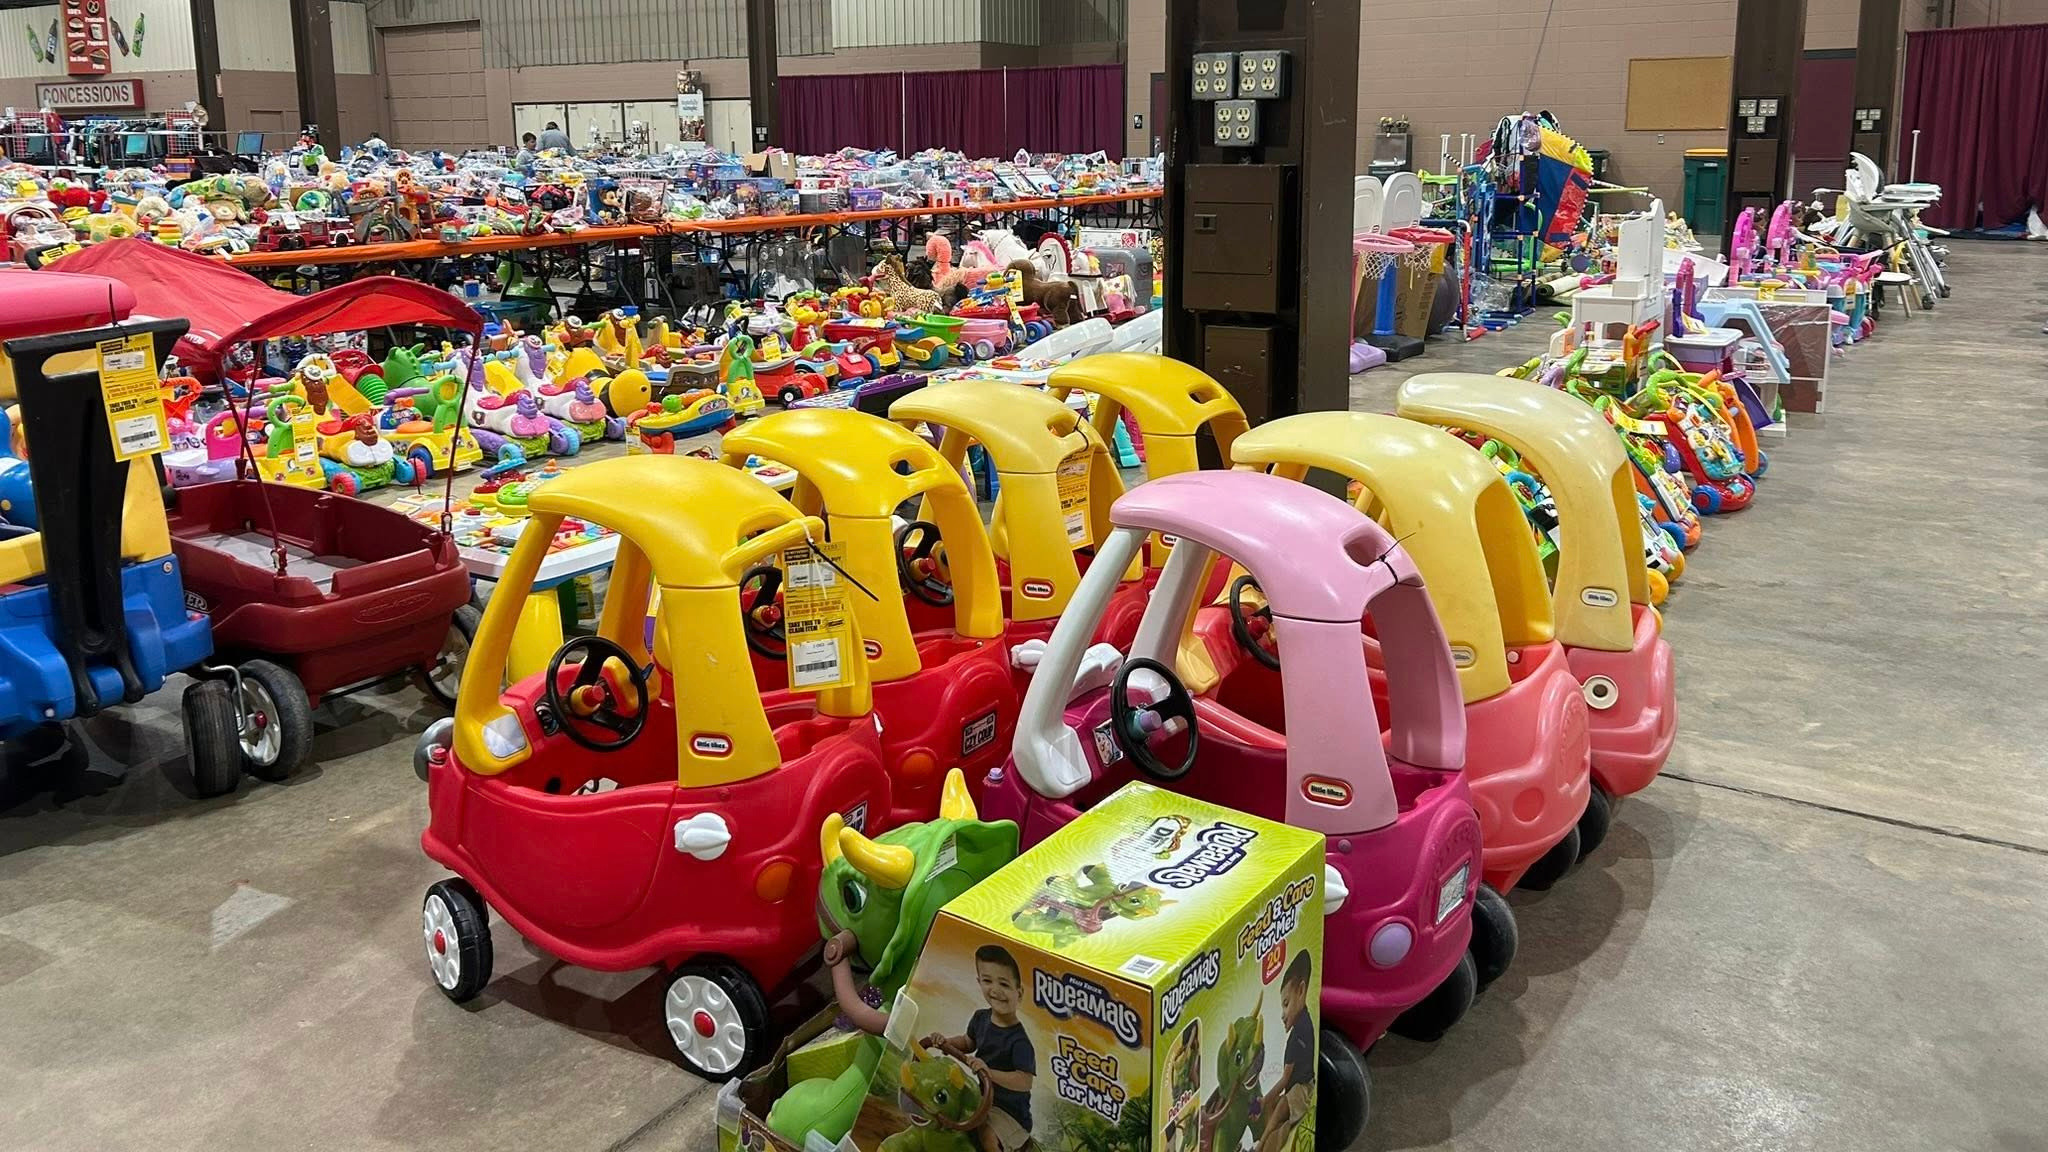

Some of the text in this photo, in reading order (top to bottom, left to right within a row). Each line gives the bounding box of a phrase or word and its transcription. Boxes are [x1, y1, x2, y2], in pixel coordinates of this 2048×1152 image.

[44, 84, 130, 104] CONCESSIONS
[1311, 785, 1325, 794] little
[1238, 877, 1314, 959] Feed & Care
[1257, 908, 1296, 959] for Me!
[1267, 946, 1280, 970] 20
[1058, 1036, 1117, 1080] Feed
[1052, 1057, 1125, 1103] & Care
[1058, 1077, 1120, 1120] for Me!
